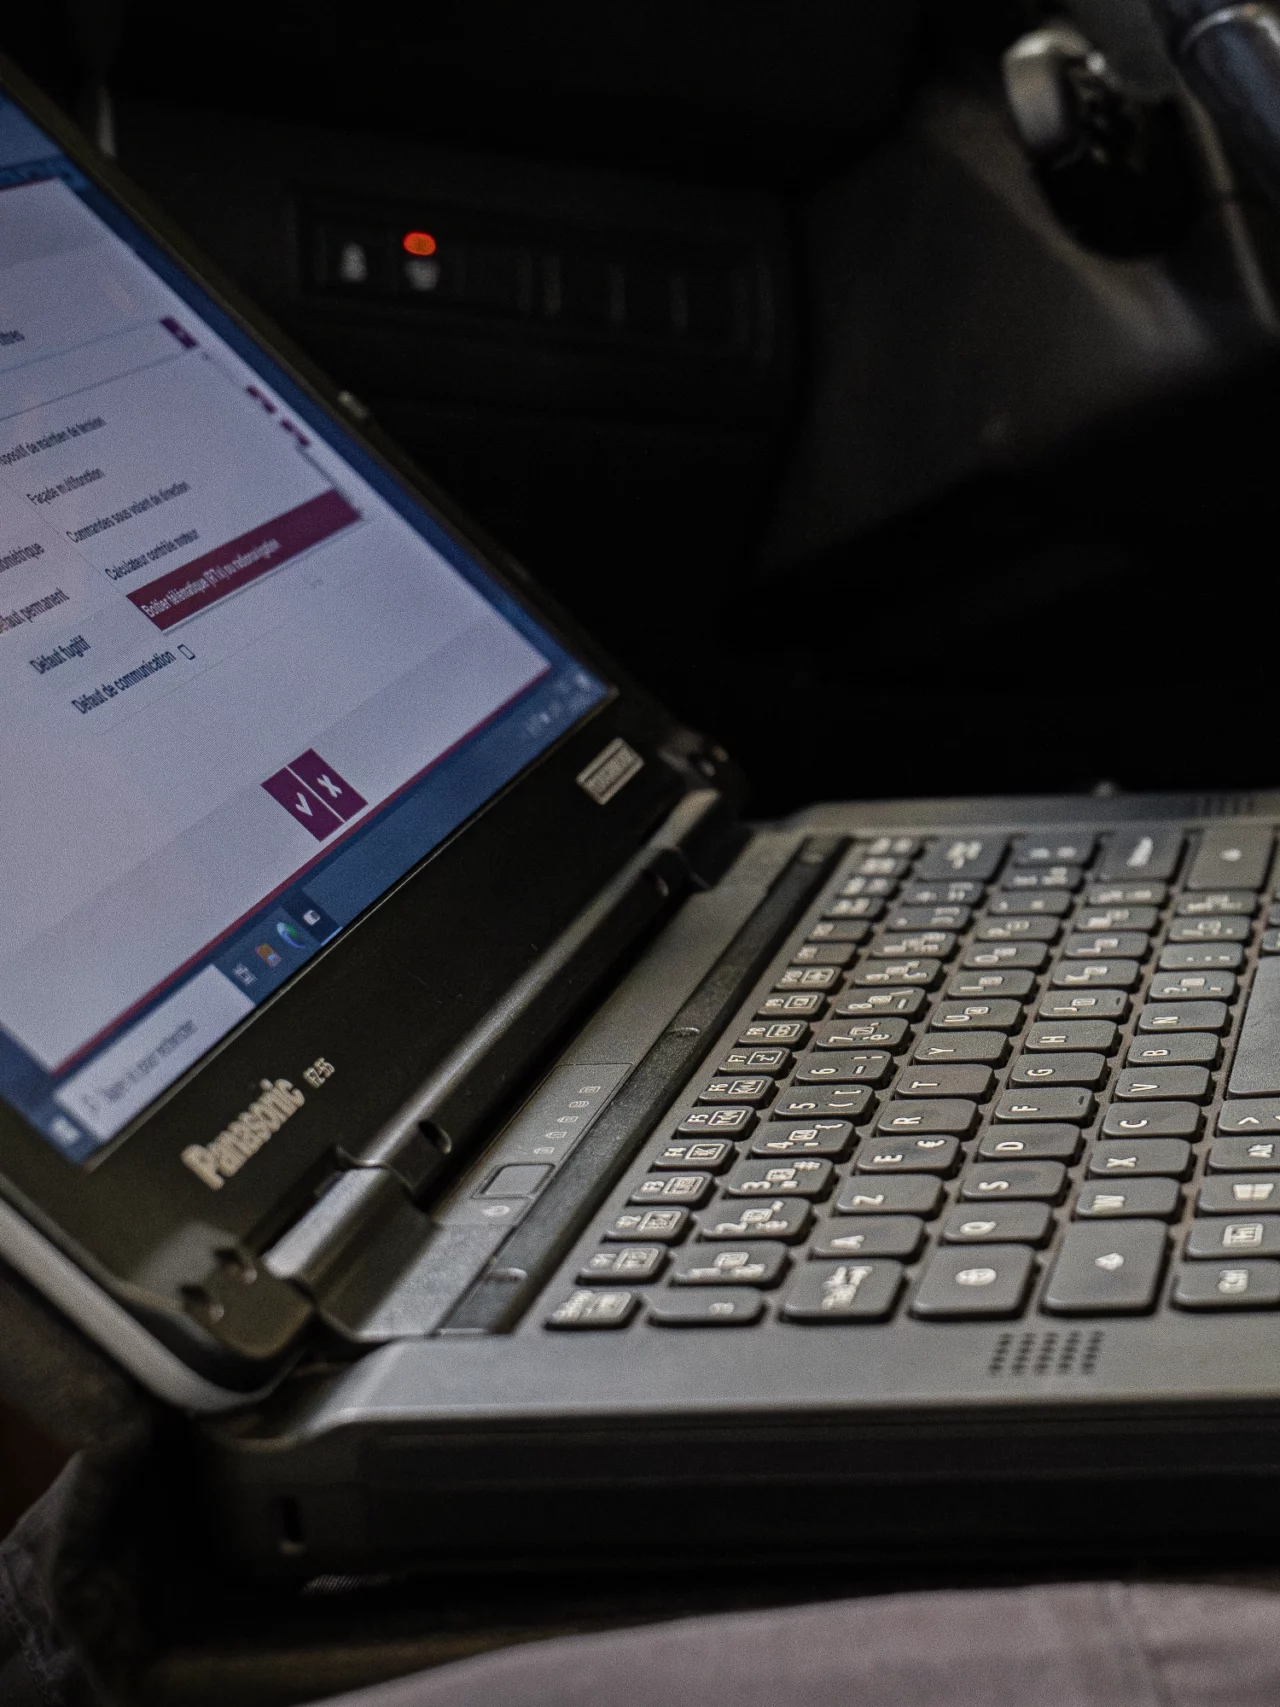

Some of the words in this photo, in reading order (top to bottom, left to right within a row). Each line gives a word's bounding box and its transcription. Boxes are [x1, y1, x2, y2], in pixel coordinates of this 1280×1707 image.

[66, 516, 116, 543] Commandes
[111, 507, 133, 524] sous
[0, 543, 44, 573] ométrique
[105, 554, 150, 581] Calculateur
[20, 587, 70, 623] permanent
[29, 645, 67, 675] Défaut
[58, 635, 91, 658] fugitif
[71, 687, 108, 715] Défaut
[101, 683, 119, 699] de
[114, 651, 177, 692] communication
[1152, 1016, 1179, 1025] N
[1039, 1035, 1067, 1043] H
[928, 1046, 955, 1055] Y
[728, 1054, 747, 1063] F7
[1027, 1068, 1054, 1076] G
[708, 1083, 729, 1092] F6
[911, 1081, 939, 1089] T
[1130, 1083, 1159, 1092] V
[687, 1113, 709, 1123] F5
[893, 1116, 922, 1125] R
[1119, 1119, 1148, 1128] C
[180, 1078, 305, 1190] Panasonic
[995, 1141, 1024, 1151] D
[1248, 1143, 1274, 1159] Alt
[664, 1147, 687, 1158] F4
[873, 1154, 903, 1163] E
[1106, 1156, 1137, 1168] X
[741, 1180, 772, 1192] 3
[978, 1180, 1010, 1191] S
[852, 1194, 884, 1206] Z
[1092, 1194, 1126, 1213] W
[959, 1220, 997, 1236] Q
[830, 1234, 865, 1250] A
